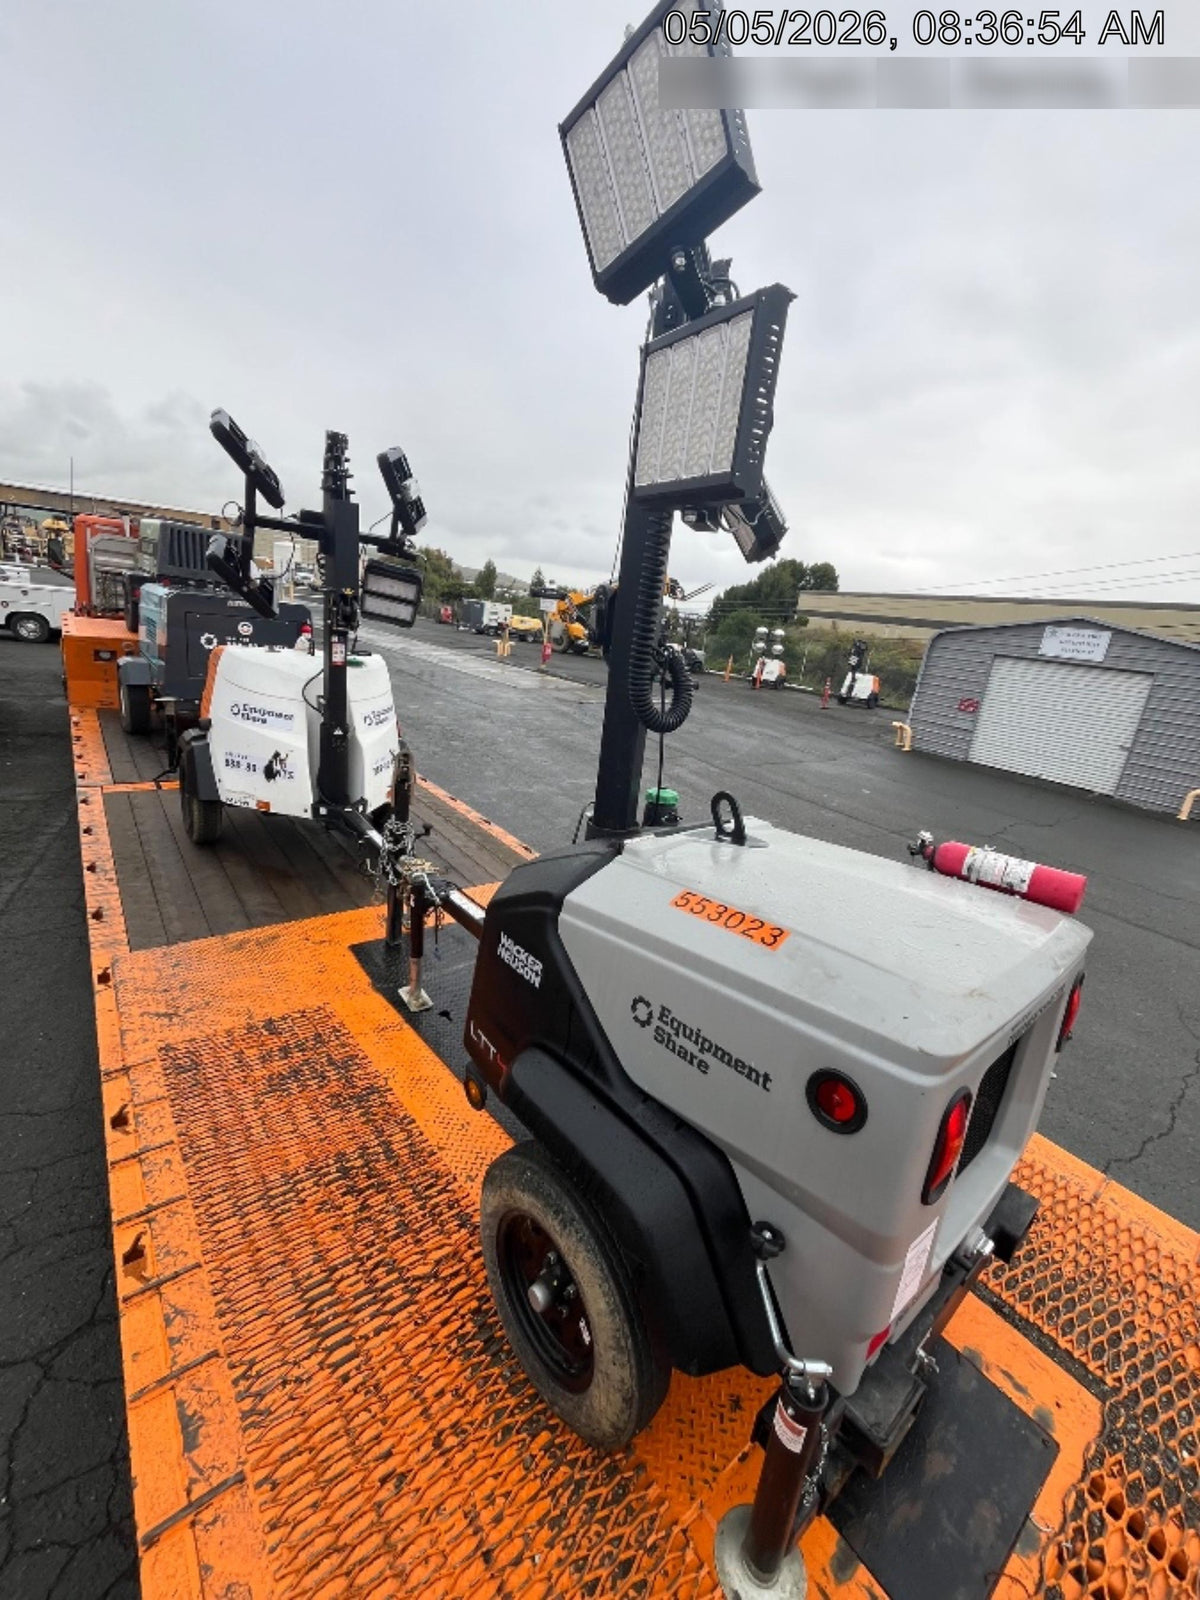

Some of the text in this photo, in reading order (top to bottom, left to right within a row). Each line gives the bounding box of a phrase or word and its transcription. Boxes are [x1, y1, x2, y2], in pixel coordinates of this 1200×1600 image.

[674, 891, 784, 947] 553023
[500, 930, 543, 970] WACKER
[653, 1025, 710, 1075] Share
[657, 1004, 773, 1093] Equipment
